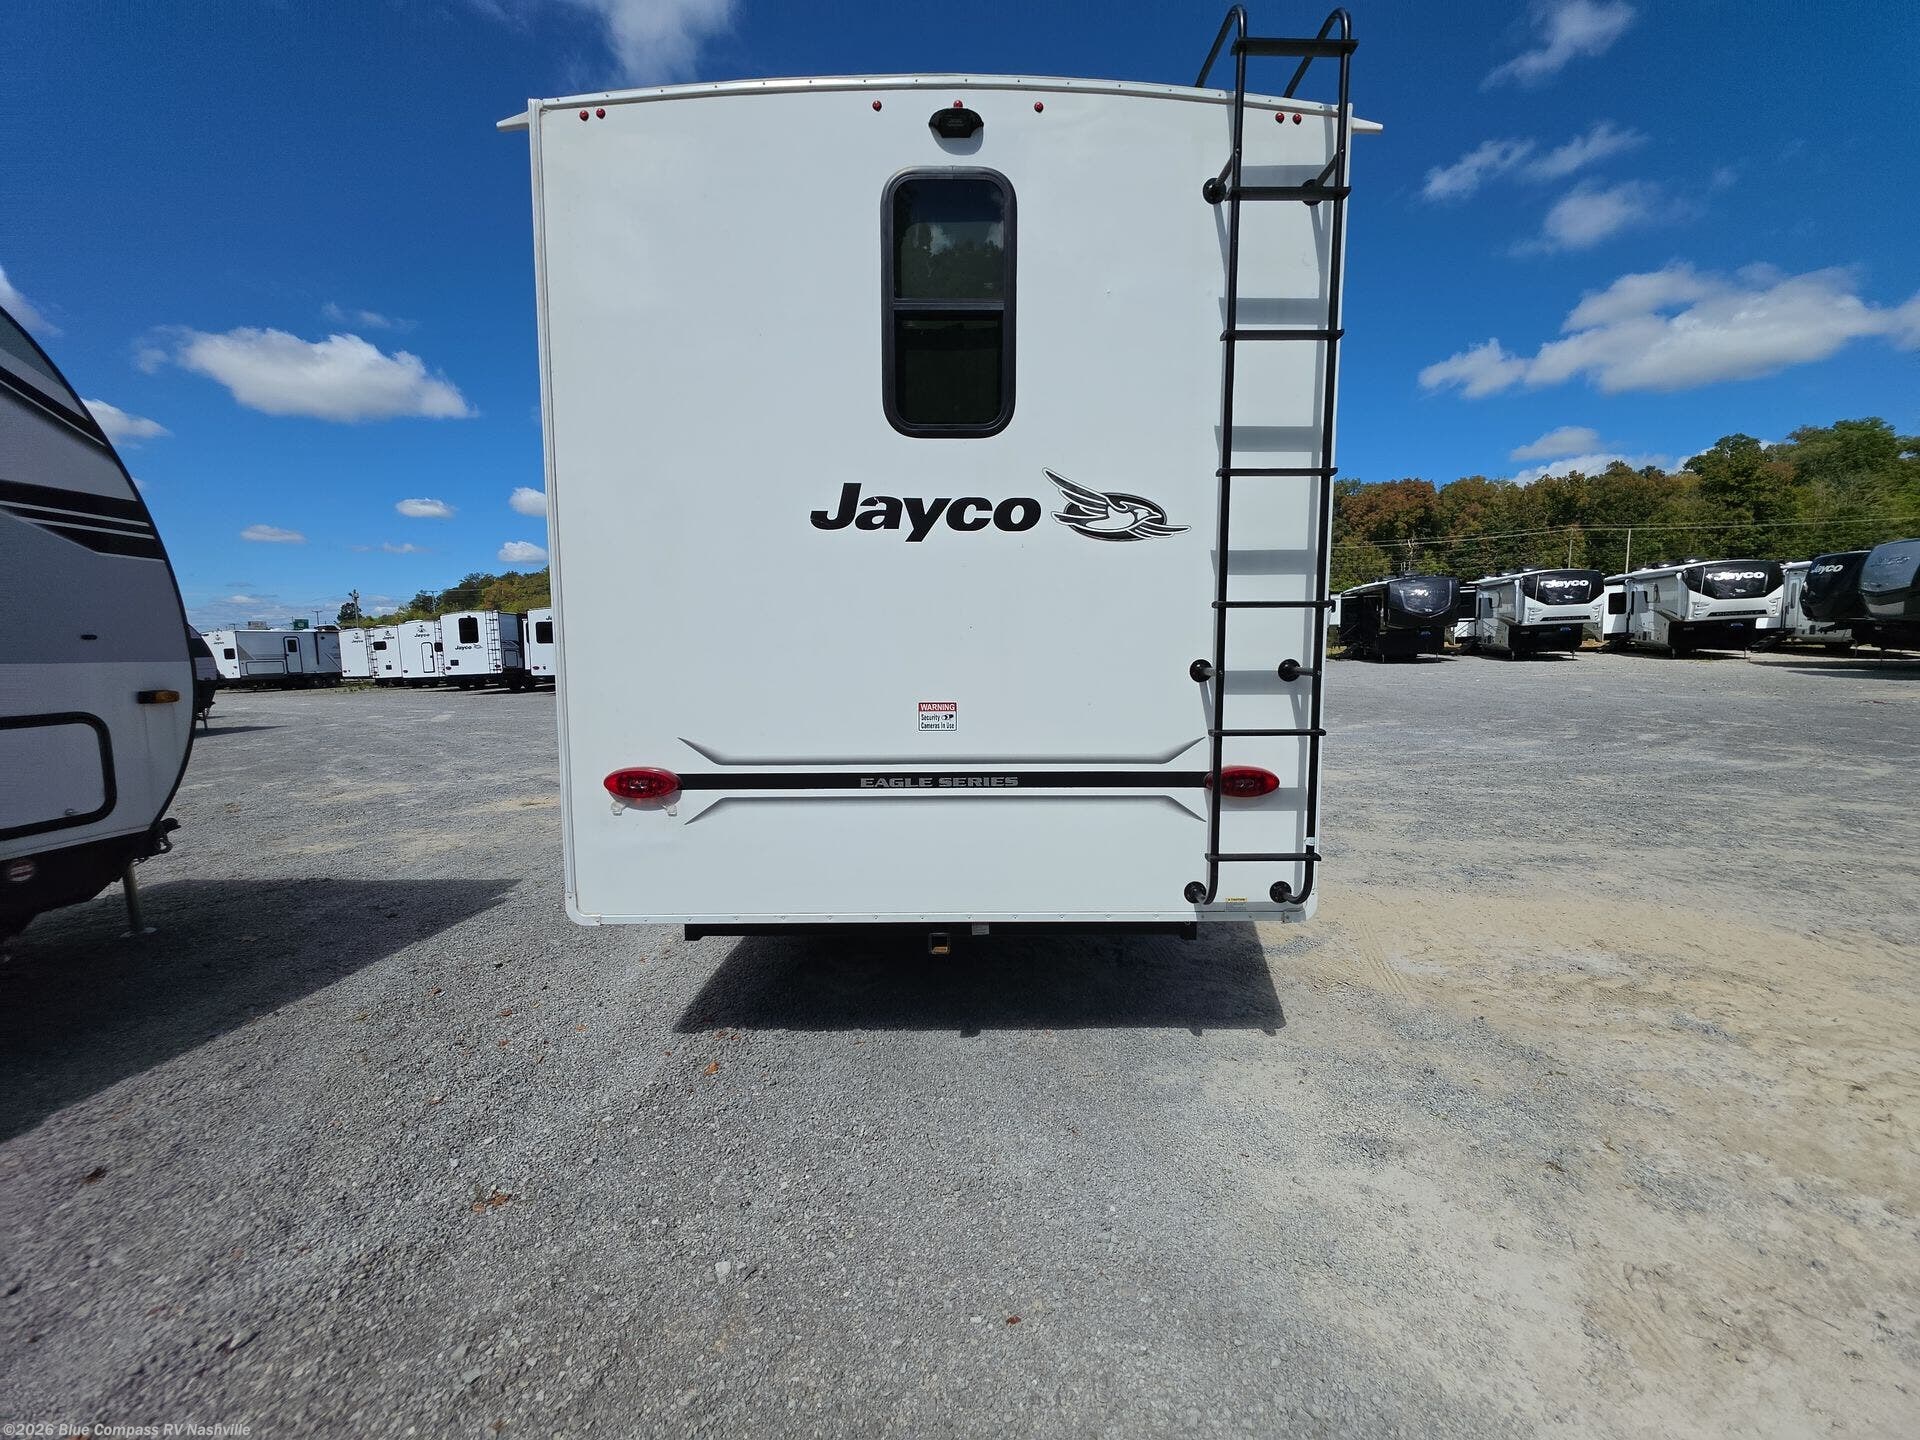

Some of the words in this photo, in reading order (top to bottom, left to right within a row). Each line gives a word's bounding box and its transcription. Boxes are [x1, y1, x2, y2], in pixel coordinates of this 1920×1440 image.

[810, 482, 1042, 543] Jayco
[1713, 571, 1766, 581] Jayco
[1545, 579, 1589, 589] Jayco
[920, 703, 955, 711] WARNING
[921, 714, 940, 722] Security
[860, 777, 933, 788] EAGLE
[938, 776, 1019, 788] SERIES
